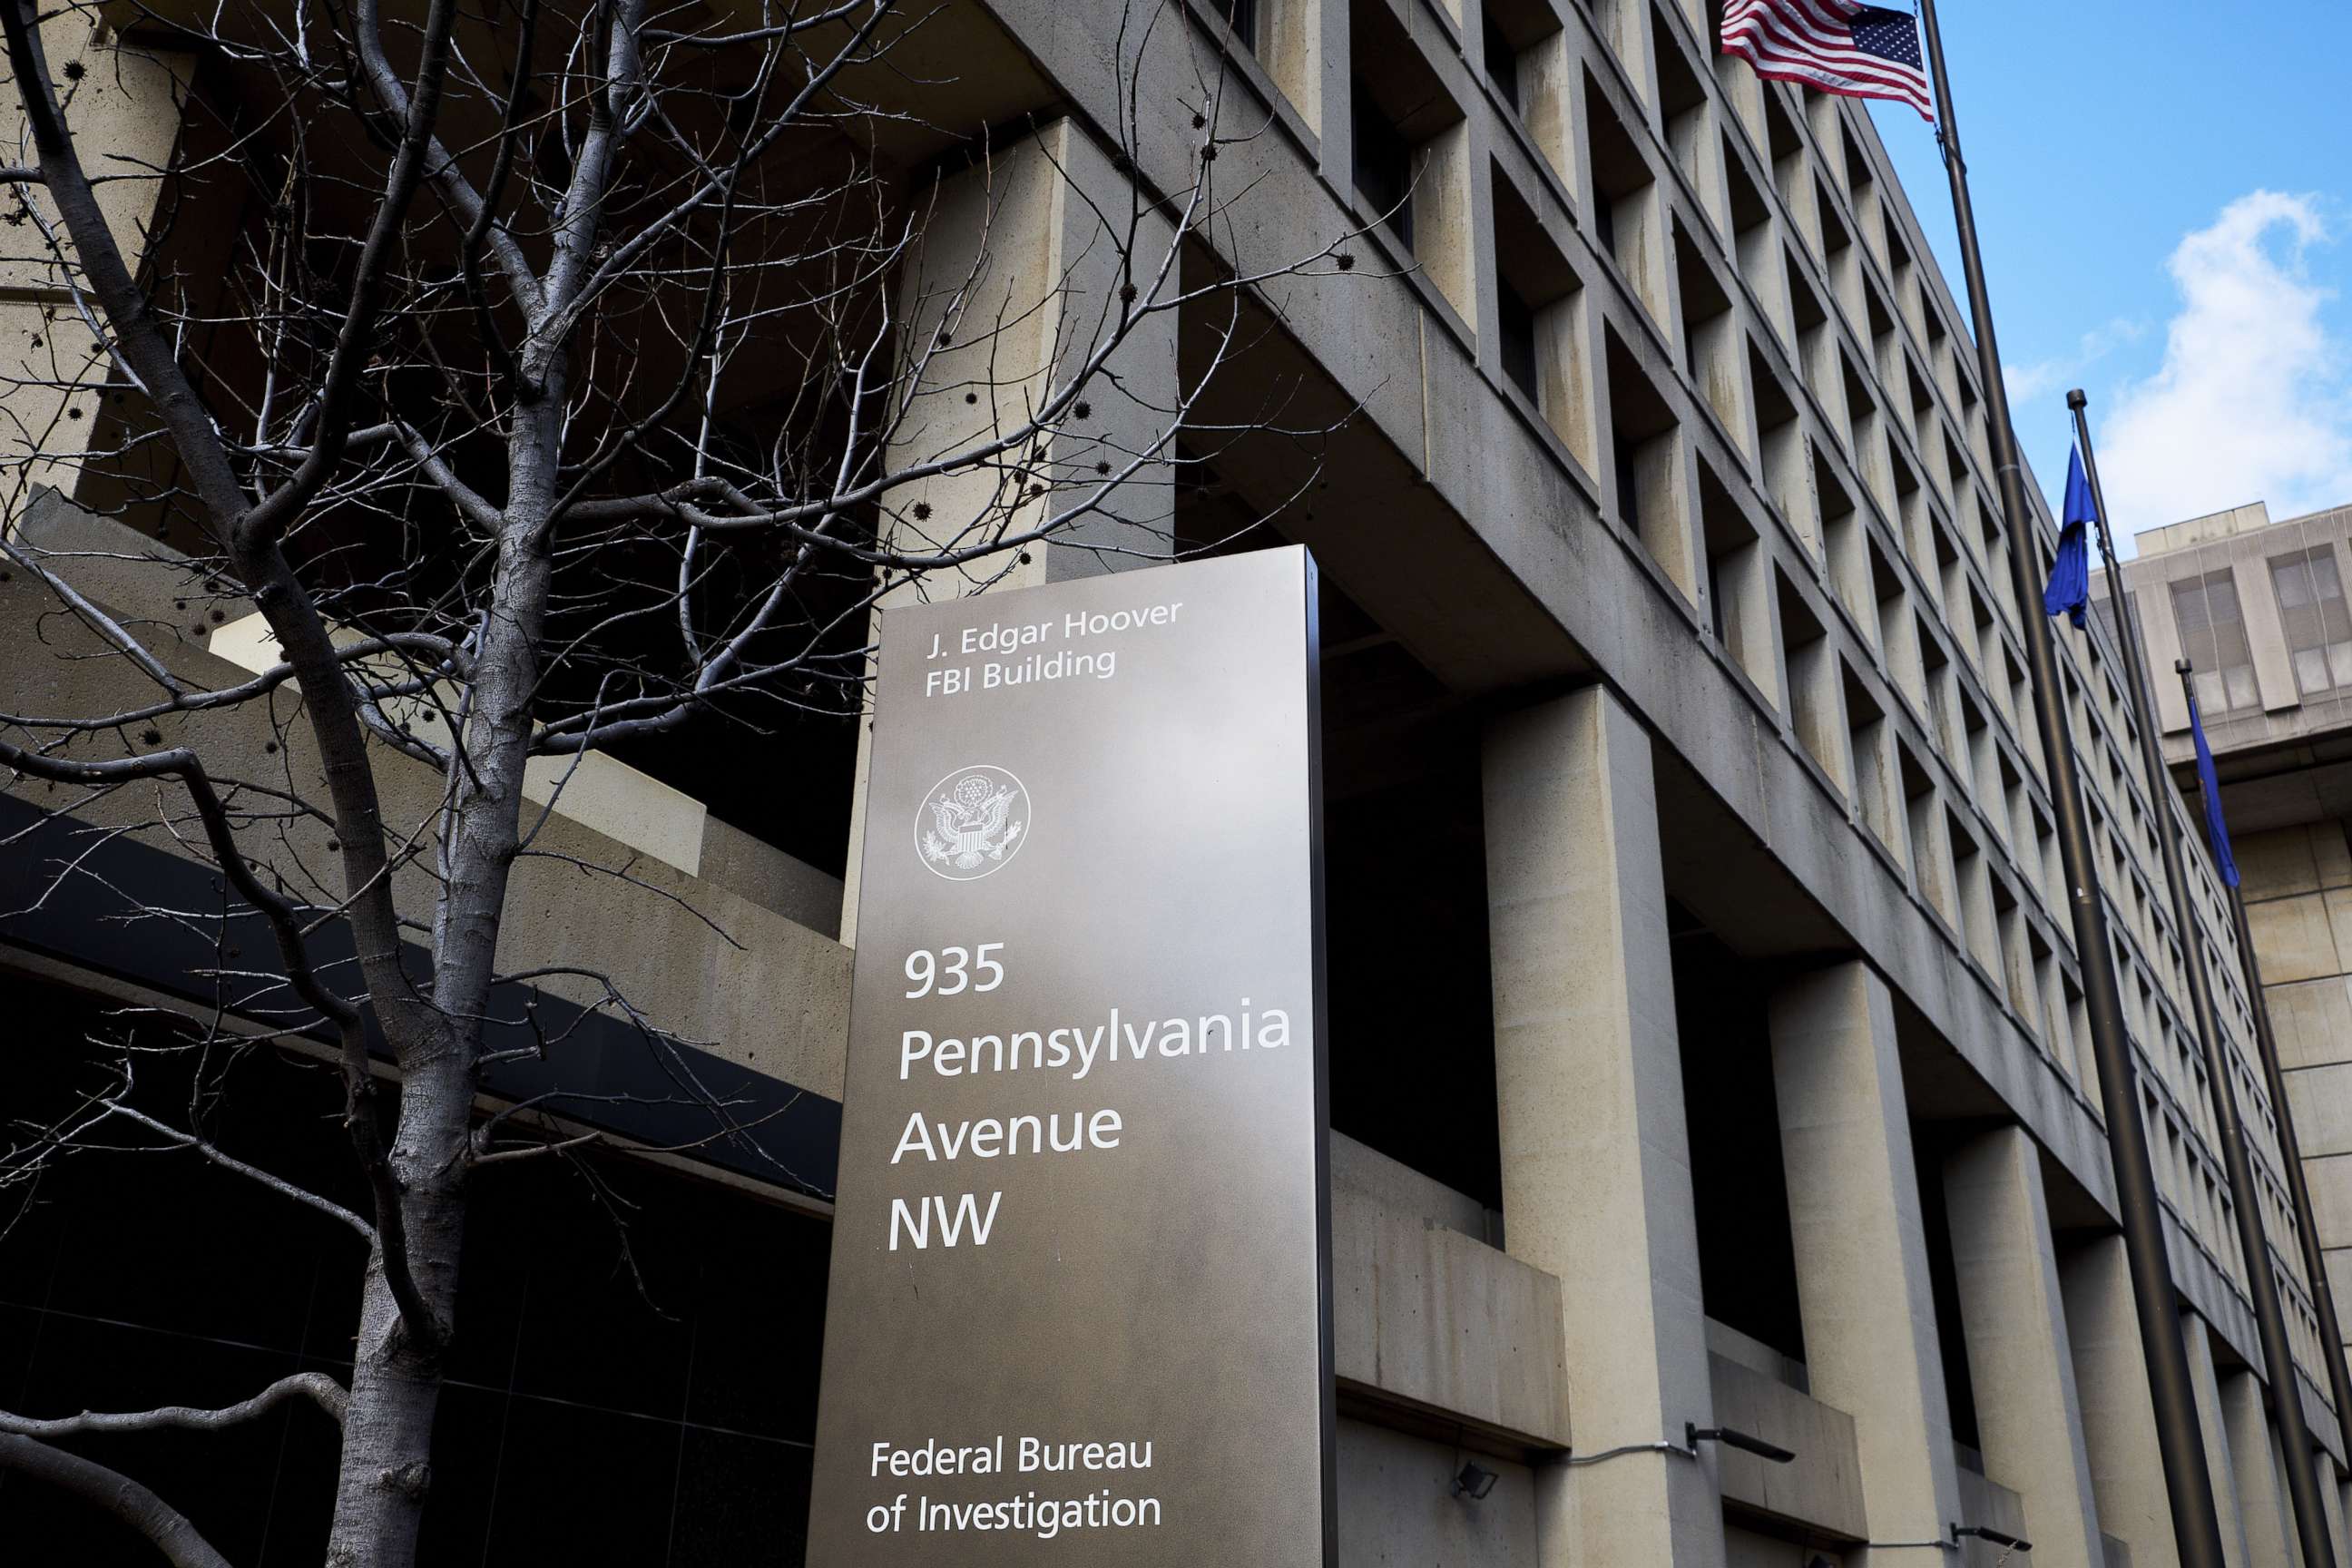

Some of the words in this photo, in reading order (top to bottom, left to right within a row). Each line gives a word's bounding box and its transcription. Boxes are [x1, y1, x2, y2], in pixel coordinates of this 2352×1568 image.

[926, 632, 947, 661] J.
[961, 620, 1053, 655] Edgar
[1064, 603, 1183, 640] Hoover
[926, 666, 970, 698] FBI
[983, 648, 1117, 690] Building
[905, 942, 1004, 999] 935
[899, 997, 1290, 1080] Pennsylvania
[890, 1107, 1122, 1164] Avenue
[888, 1191, 1002, 1251] NW
[871, 1436, 1003, 1477] Federal
[1018, 1436, 1152, 1473] Bureau
[866, 1494, 906, 1533] of
[919, 1489, 1161, 1539] Investigation
